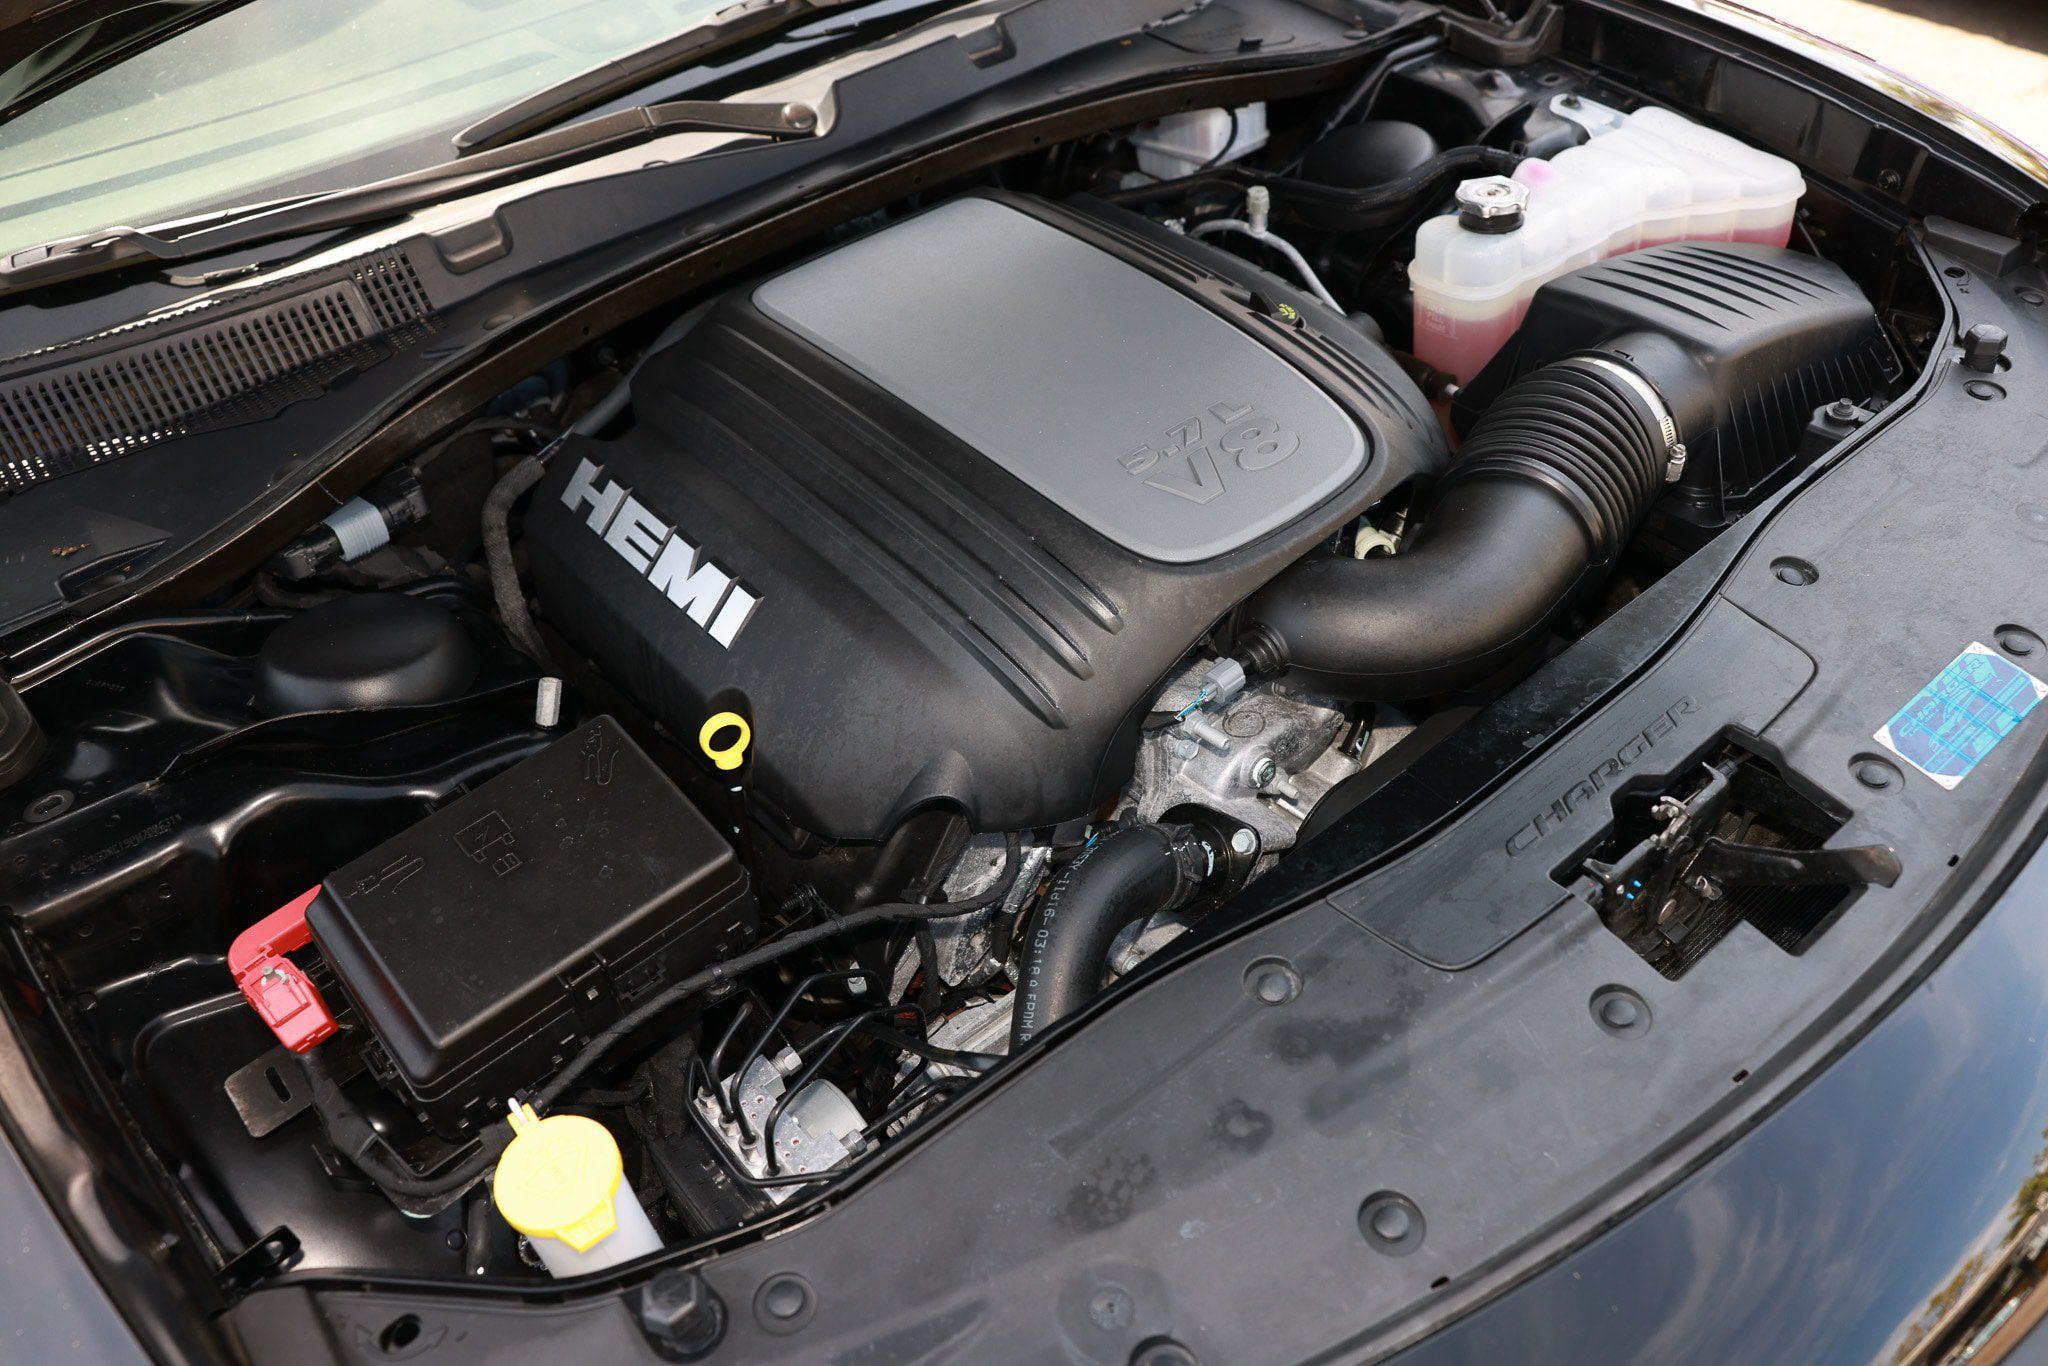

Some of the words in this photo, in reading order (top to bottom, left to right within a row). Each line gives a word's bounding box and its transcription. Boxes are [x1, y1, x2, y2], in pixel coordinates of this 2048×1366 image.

[1141, 416, 1301, 504] V8
[560, 456, 766, 651] HEMI
[1505, 695, 1702, 858] CHARGER
